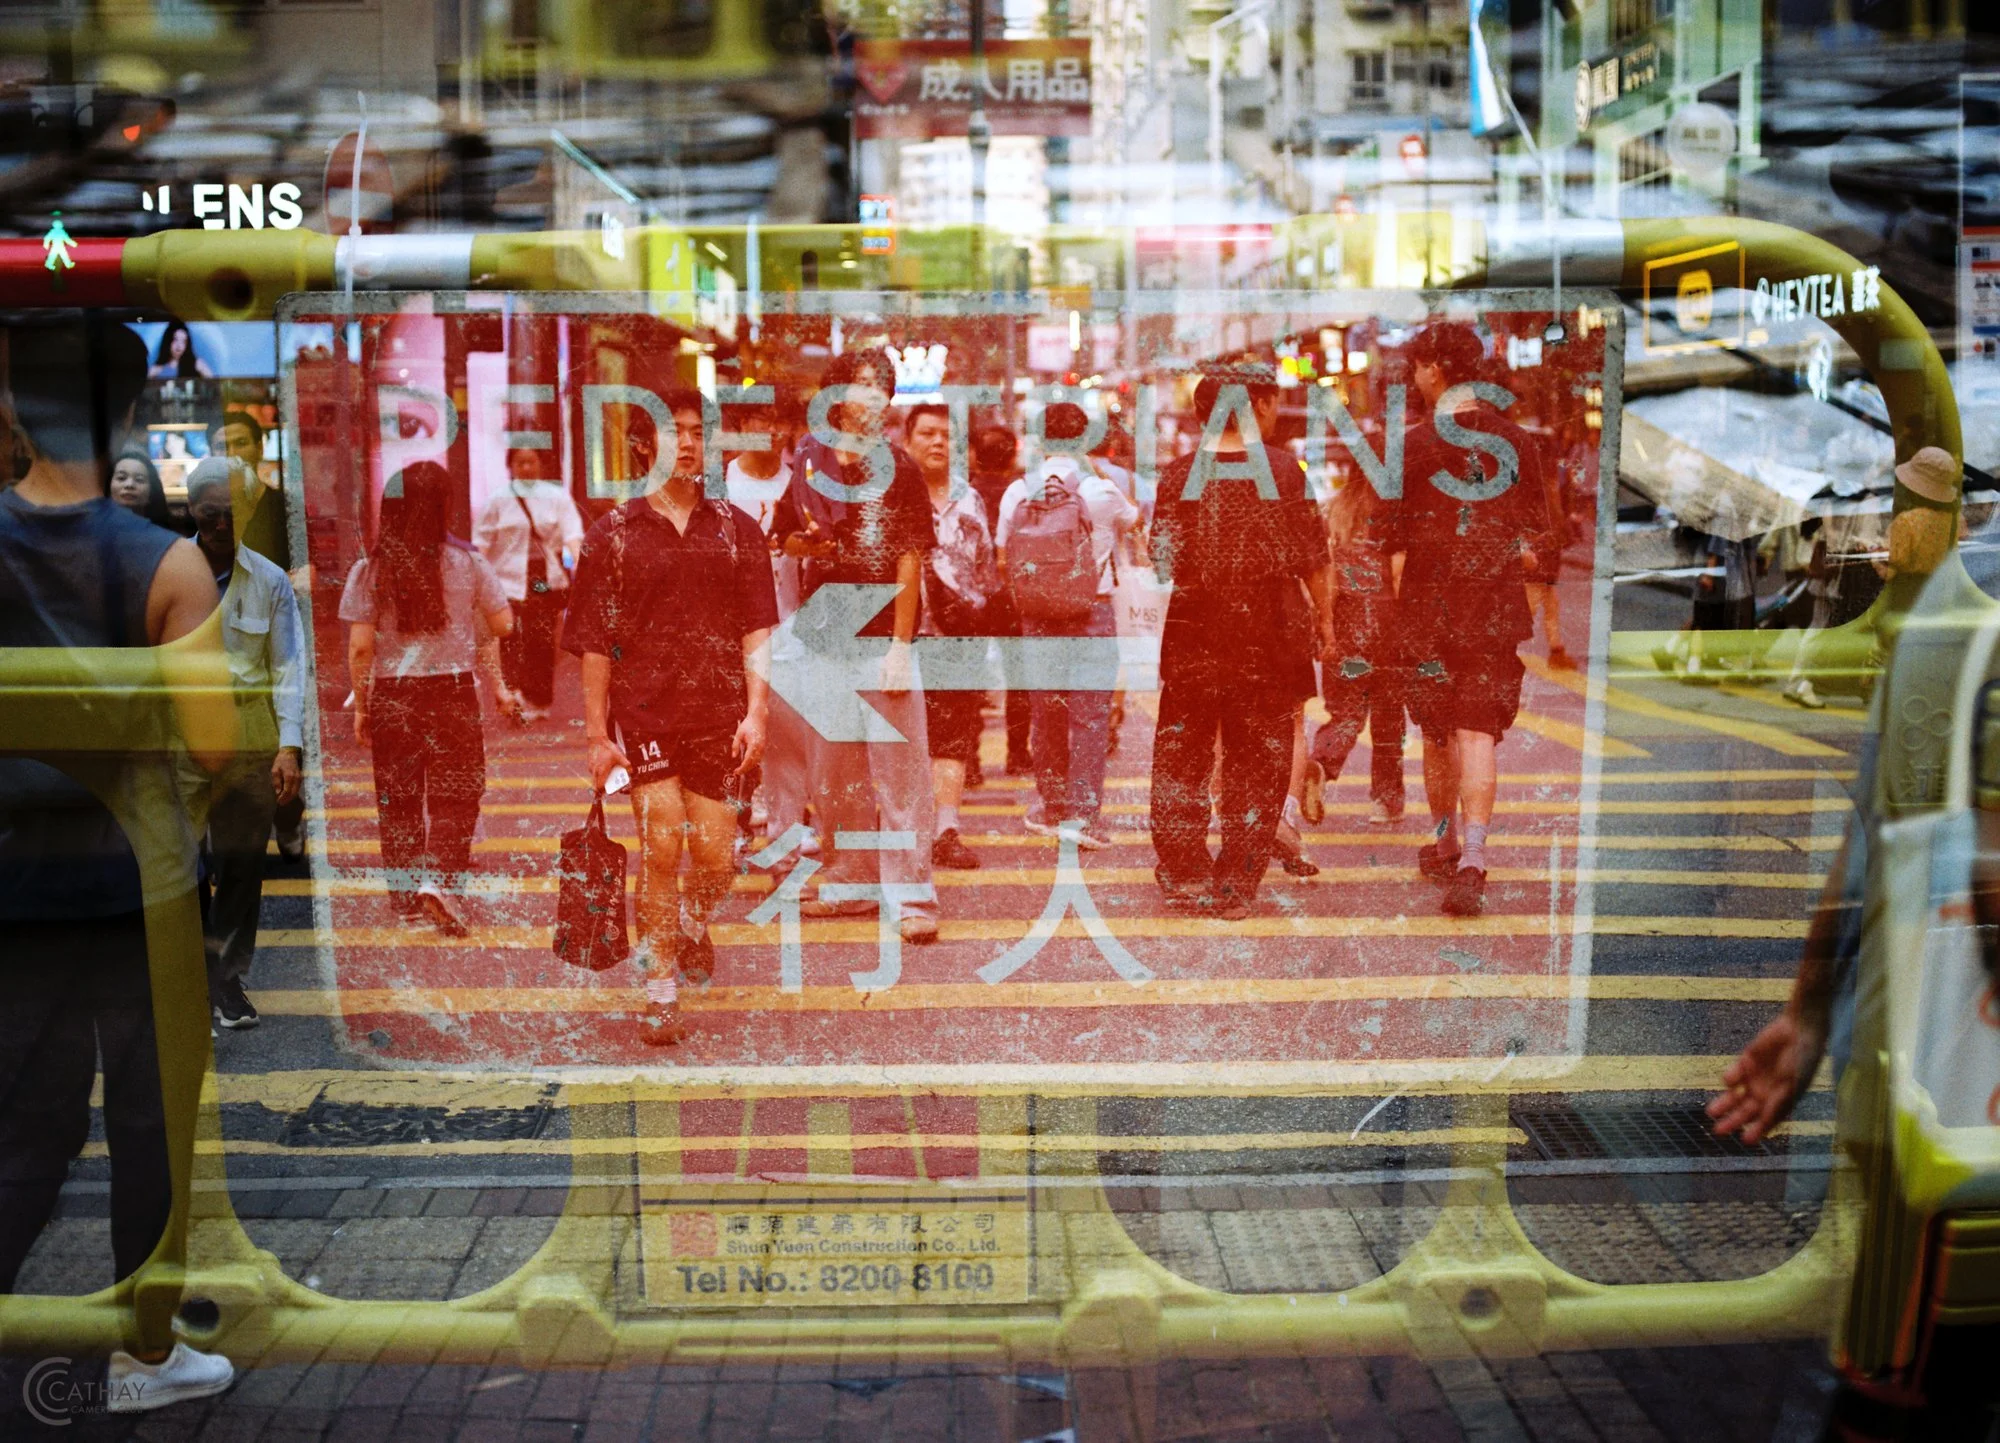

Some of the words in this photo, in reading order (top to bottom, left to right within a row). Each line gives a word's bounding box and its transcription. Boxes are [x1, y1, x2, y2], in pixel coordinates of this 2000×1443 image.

[919, 57, 1089, 102] 成人用品
[1772, 273, 1845, 324] HEYTEA
[377, 381, 1520, 502] PEDESTRIANS
[637, 764, 648, 774] YU
[648, 759, 669, 772] CHING
[638, 740, 661, 761] 14
[745, 821, 1157, 993] 行人
[727, 1240, 770, 1254] Shun
[774, 1240, 814, 1254] Yuen
[819, 1239, 928, 1254] Construction
[969, 1239, 1000, 1252] Ltd.
[677, 1265, 727, 1293] Tel
[738, 1265, 808, 1293] No.:
